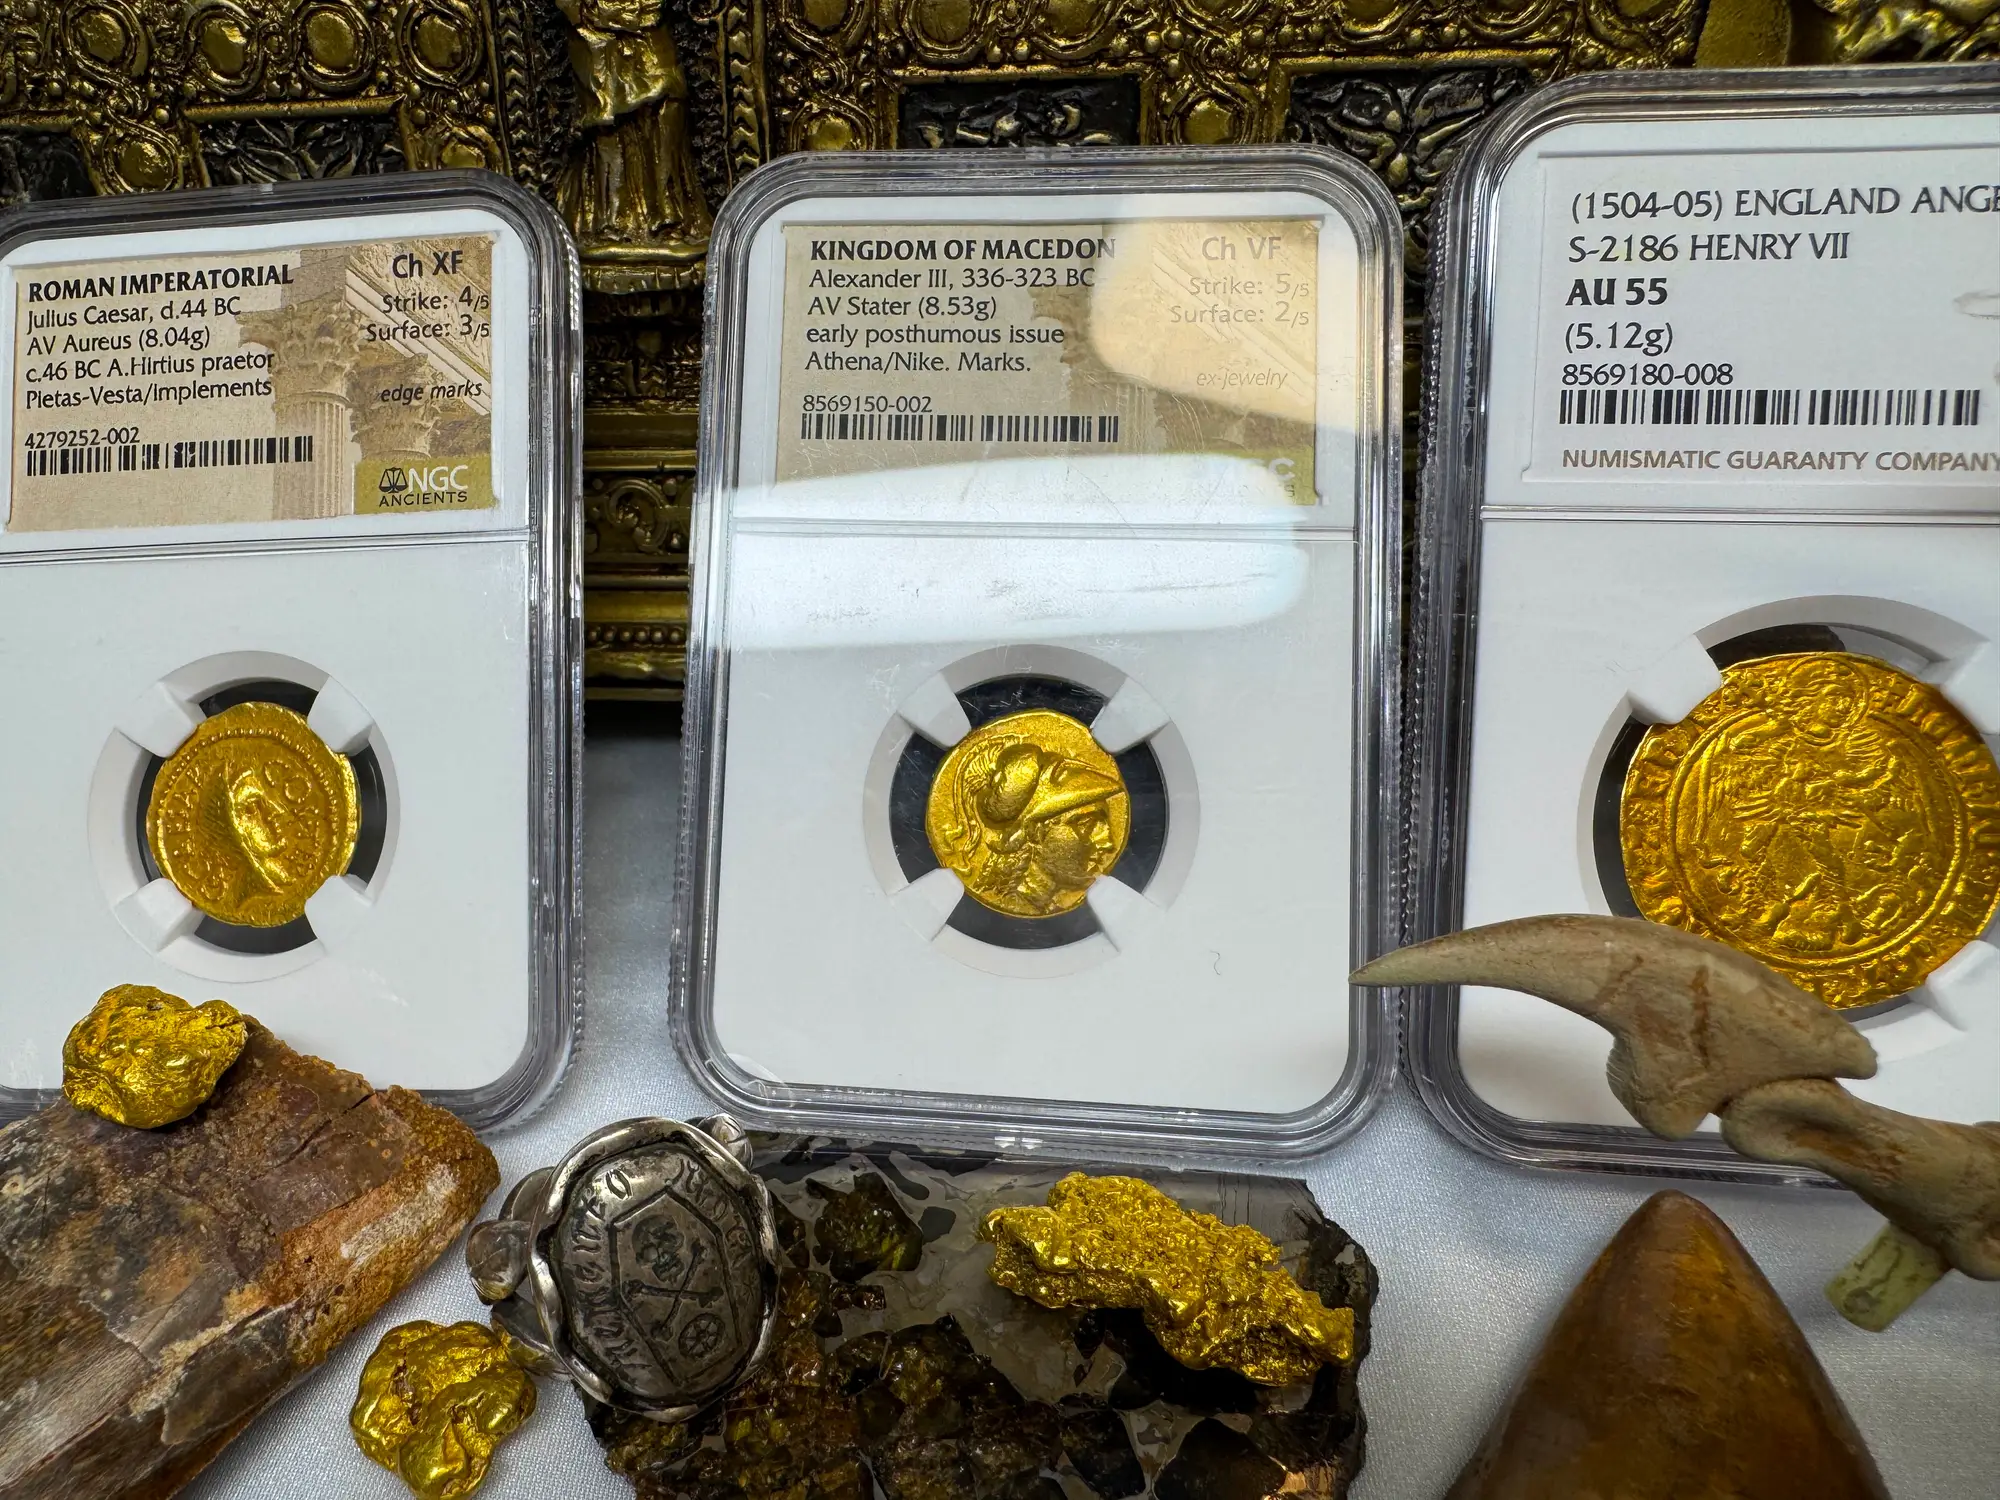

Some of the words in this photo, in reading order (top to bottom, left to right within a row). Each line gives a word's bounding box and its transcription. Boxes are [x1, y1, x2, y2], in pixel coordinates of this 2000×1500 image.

[1571, 190, 1724, 224] (1504-05)
[1735, 187, 1900, 216] ENGLAND
[810, 240, 938, 260] KINGDOM
[943, 239, 978, 260] OF
[981, 238, 1116, 260] MACEDON
[1201, 236, 1237, 261] Ch
[1246, 236, 1282, 260] VF
[1568, 234, 1679, 263] S-2186
[1689, 233, 1802, 261] HENRY
[1808, 232, 1850, 260] VII
[392, 253, 424, 279] Ch
[432, 250, 463, 276] XF
[29, 276, 116, 303] ROMAN
[120, 264, 294, 296] IMPERATORIAL
[808, 268, 921, 289] Alexander
[928, 269, 954, 291] III,
[961, 267, 1057, 288] 336-323
[1066, 268, 1096, 287] BC
[1189, 275, 1263, 296] Strike:
[1275, 273, 1310, 300] 5/5
[1565, 278, 1617, 306] AU
[1625, 277, 1668, 305] 55
[382, 292, 448, 313] Strike:
[458, 285, 490, 312] 4/5
[807, 296, 842, 315] AV
[846, 296, 911, 316] Stater
[918, 296, 997, 321] (8.53g)
[27, 308, 77, 335] Julius
[83, 304, 154, 325] Caesar,
[160, 299, 208, 320] d.44
[214, 296, 242, 317] BC
[366, 320, 451, 341] Surface:
[460, 314, 490, 340] 3/5
[1170, 303, 1265, 323] Surface:
[1274, 301, 1310, 328] 2/5
[26, 336, 57, 356] AV
[62, 334, 132, 354] Aureus
[139, 326, 210, 351] (8.04g)
[806, 324, 859, 348] early
[865, 324, 1002, 348] posthumous
[1008, 325, 1066, 343] issue
[1564, 321, 1674, 356] (5.12g)
[26, 362, 68, 383] c.46
[74, 359, 101, 380] BC
[107, 356, 195, 378] A.Hirtius
[201, 352, 275, 376] praetor
[804, 351, 950, 374] Athena/Nike.
[957, 352, 1031, 372] Marks.
[1562, 363, 1734, 386] 8569180-008
[1196, 367, 1288, 390] ex-jewelry
[380, 384, 424, 406] edge
[430, 379, 482, 399] marks
[802, 394, 933, 413] 8569150-002
[24, 427, 140, 450] 4279252-002
[1562, 449, 1720, 469] NUMISMATIC
[1727, 451, 1869, 471] GUARANTY
[1875, 451, 2000, 471] COMPANY
[408, 464, 469, 494] NGC
[379, 490, 468, 508] ANCIENTS
